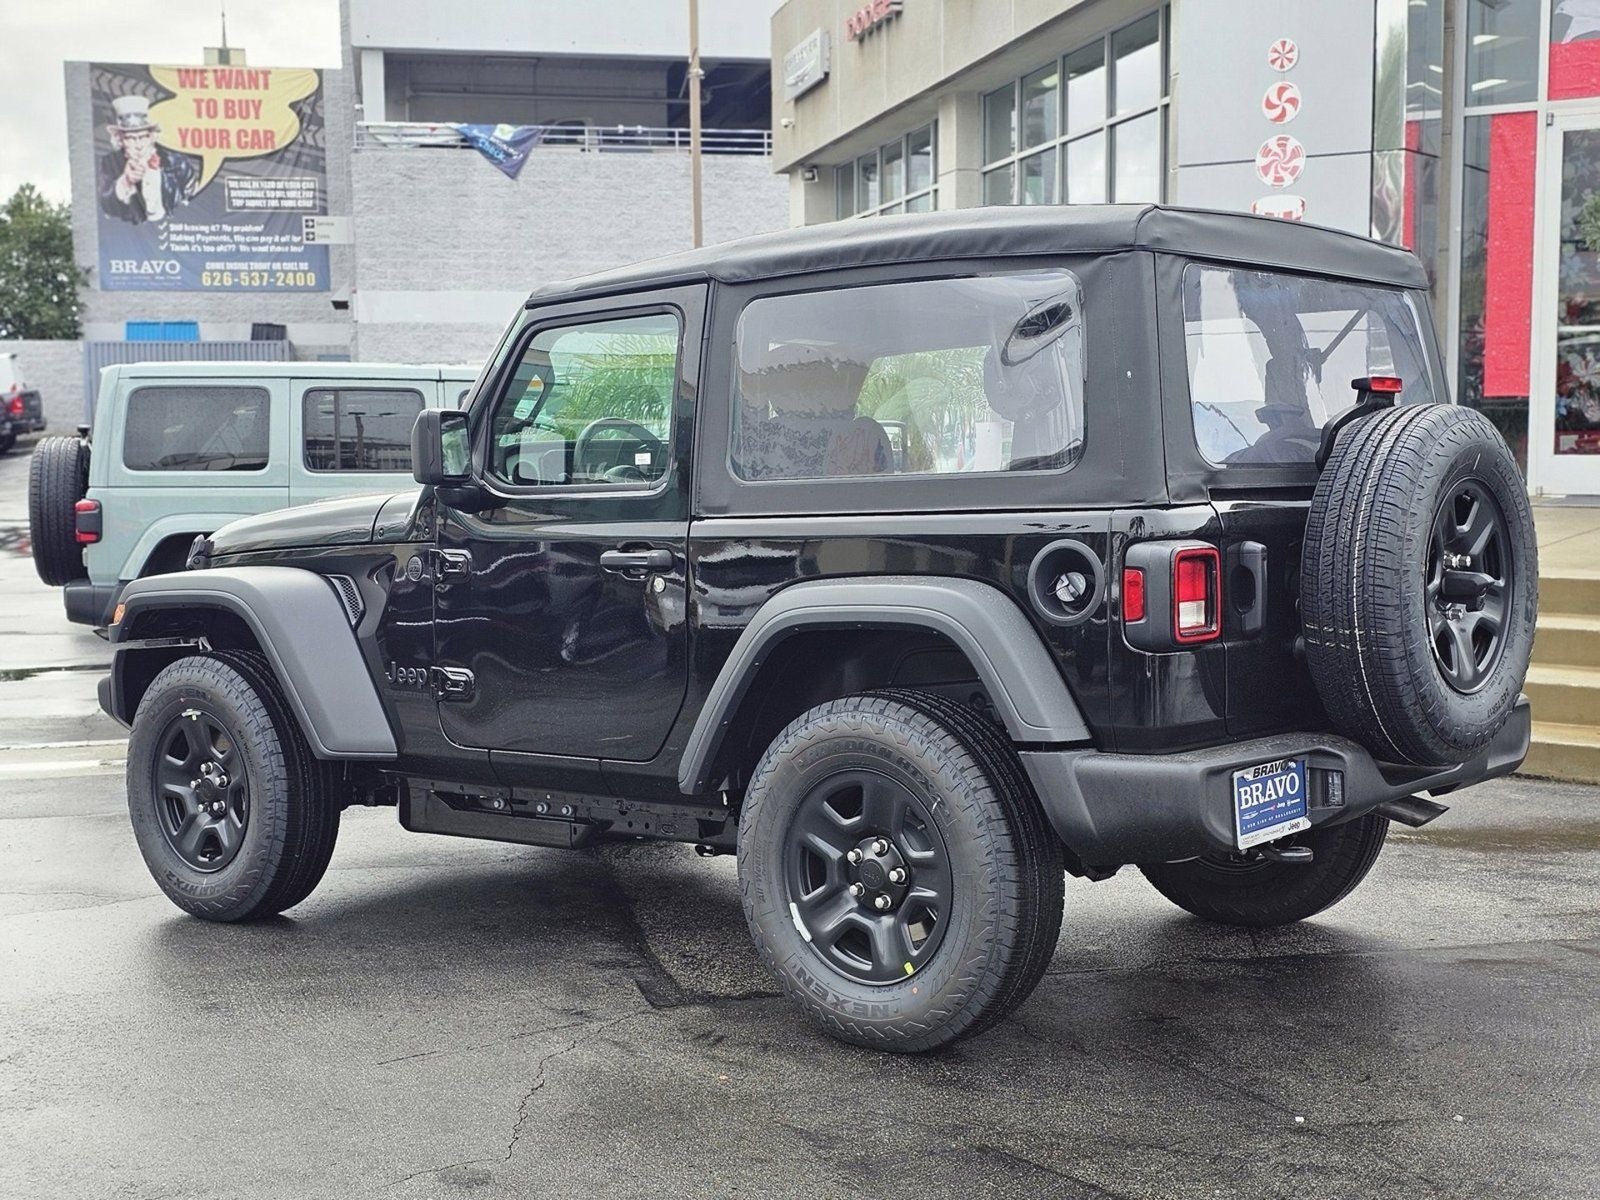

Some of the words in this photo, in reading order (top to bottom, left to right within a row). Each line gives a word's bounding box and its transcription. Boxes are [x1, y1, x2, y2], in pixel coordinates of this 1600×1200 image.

[177, 69, 208, 89] WE
[212, 70, 271, 90] WANT
[193, 98, 217, 119] TO
[224, 100, 262, 119] BUY
[178, 127, 230, 149] YOUR
[236, 129, 275, 149] CAR
[110, 259, 181, 274] BRAVO
[202, 272, 316, 287] 626-537-2400
[385, 661, 427, 688] Jeep
[1252, 761, 1289, 779] BRAVO
[1239, 772, 1300, 809] BRAVO
[1288, 820, 1301, 831] Jeep
[796, 966, 889, 1018] NEXEN
